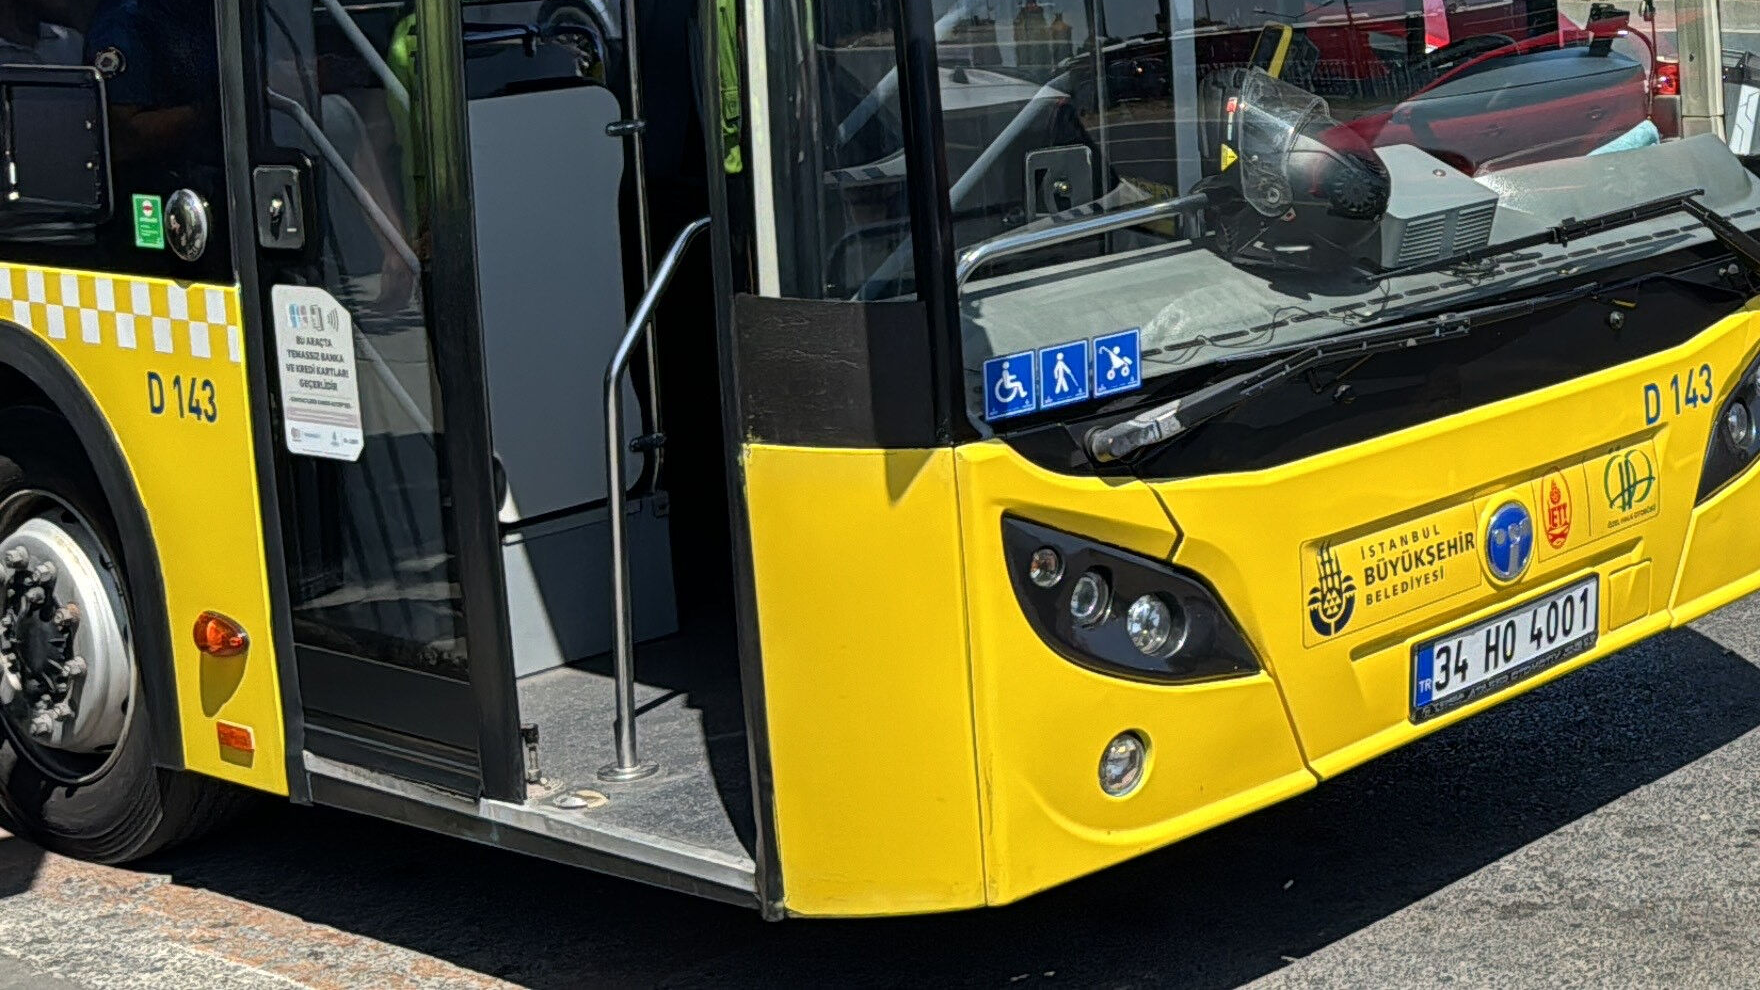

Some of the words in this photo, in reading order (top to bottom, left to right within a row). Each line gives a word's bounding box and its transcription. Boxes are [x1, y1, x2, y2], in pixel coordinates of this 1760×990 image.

[147, 371, 165, 415] D
[173, 373, 217, 423] 143
[1644, 383, 1662, 426] D
[1670, 363, 1714, 415] 143
[1360, 523, 1440, 560] İSTANBUL
[1364, 531, 1475, 587] BÜYÜKŞEHİR
[1366, 565, 1444, 606] BELEDİYESİ
[1418, 678, 1432, 693] TR
[1434, 639, 1469, 692] 34
[1530, 587, 1589, 650] 4001
